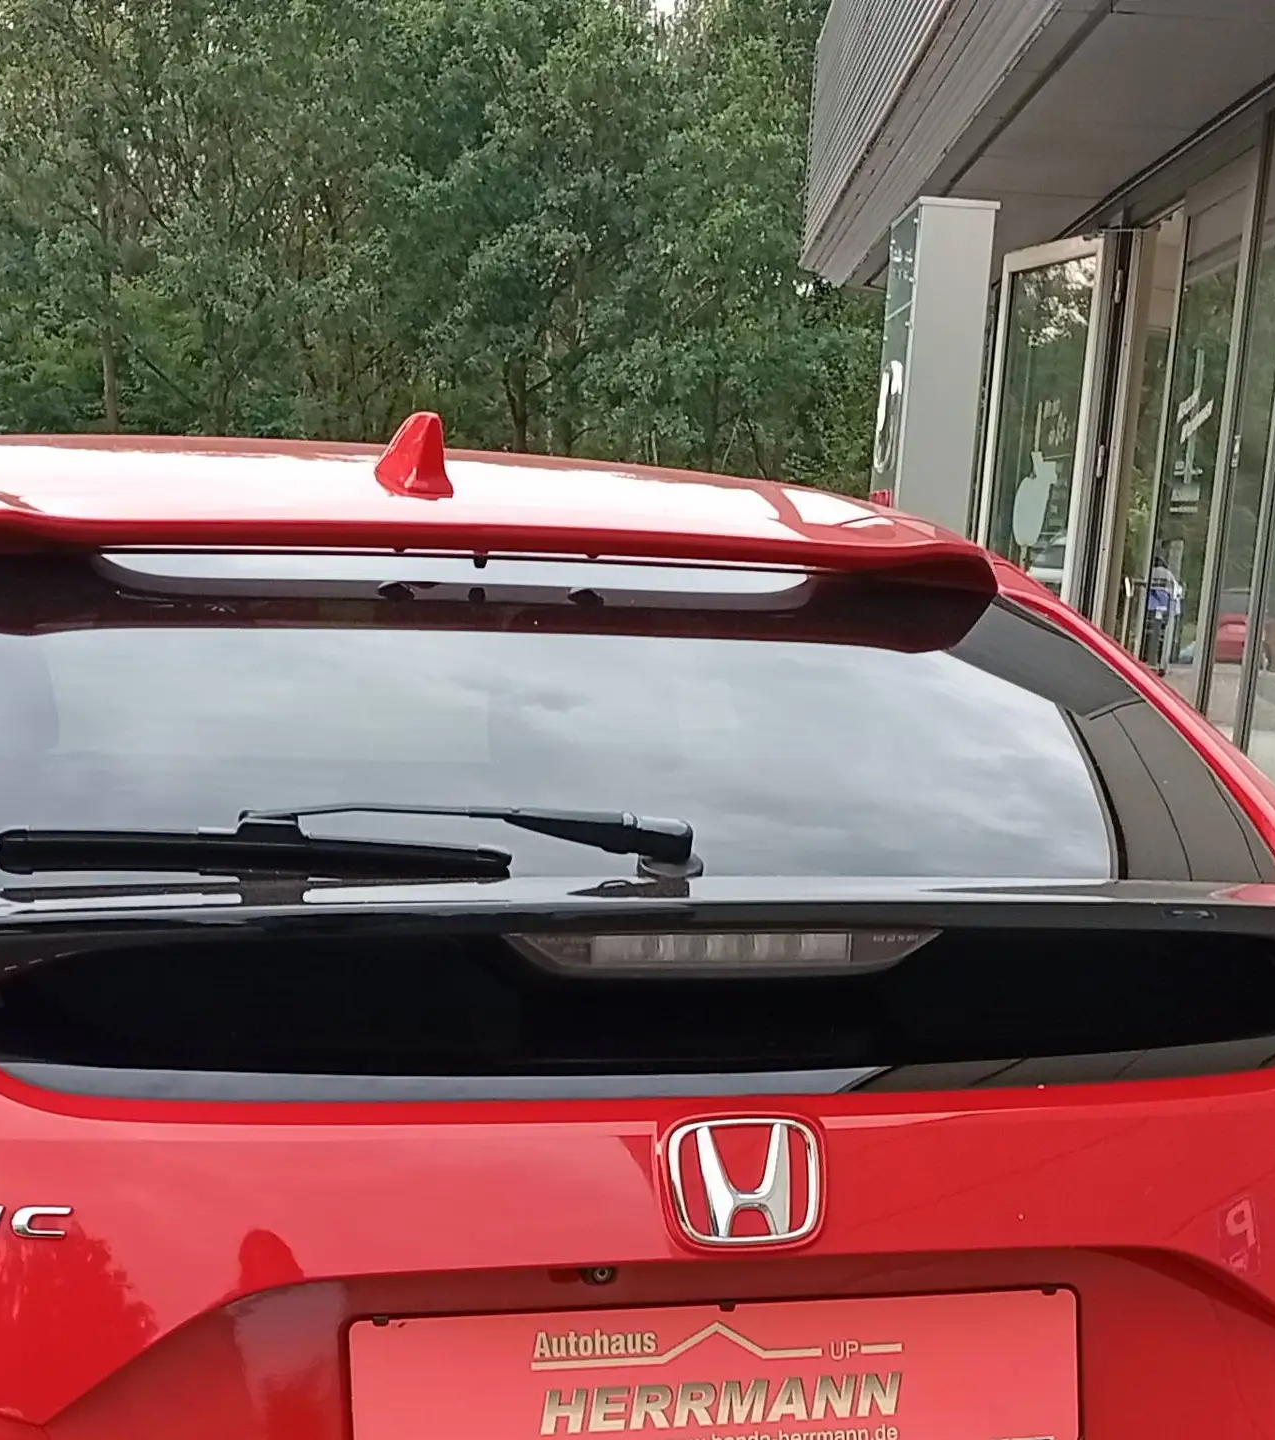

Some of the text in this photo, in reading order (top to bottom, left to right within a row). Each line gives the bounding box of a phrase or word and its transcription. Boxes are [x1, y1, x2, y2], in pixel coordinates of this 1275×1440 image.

[533, 1329, 658, 1358] Autohaus
[830, 1341, 860, 1361] UP
[540, 1372, 902, 1435] HERRMANN
